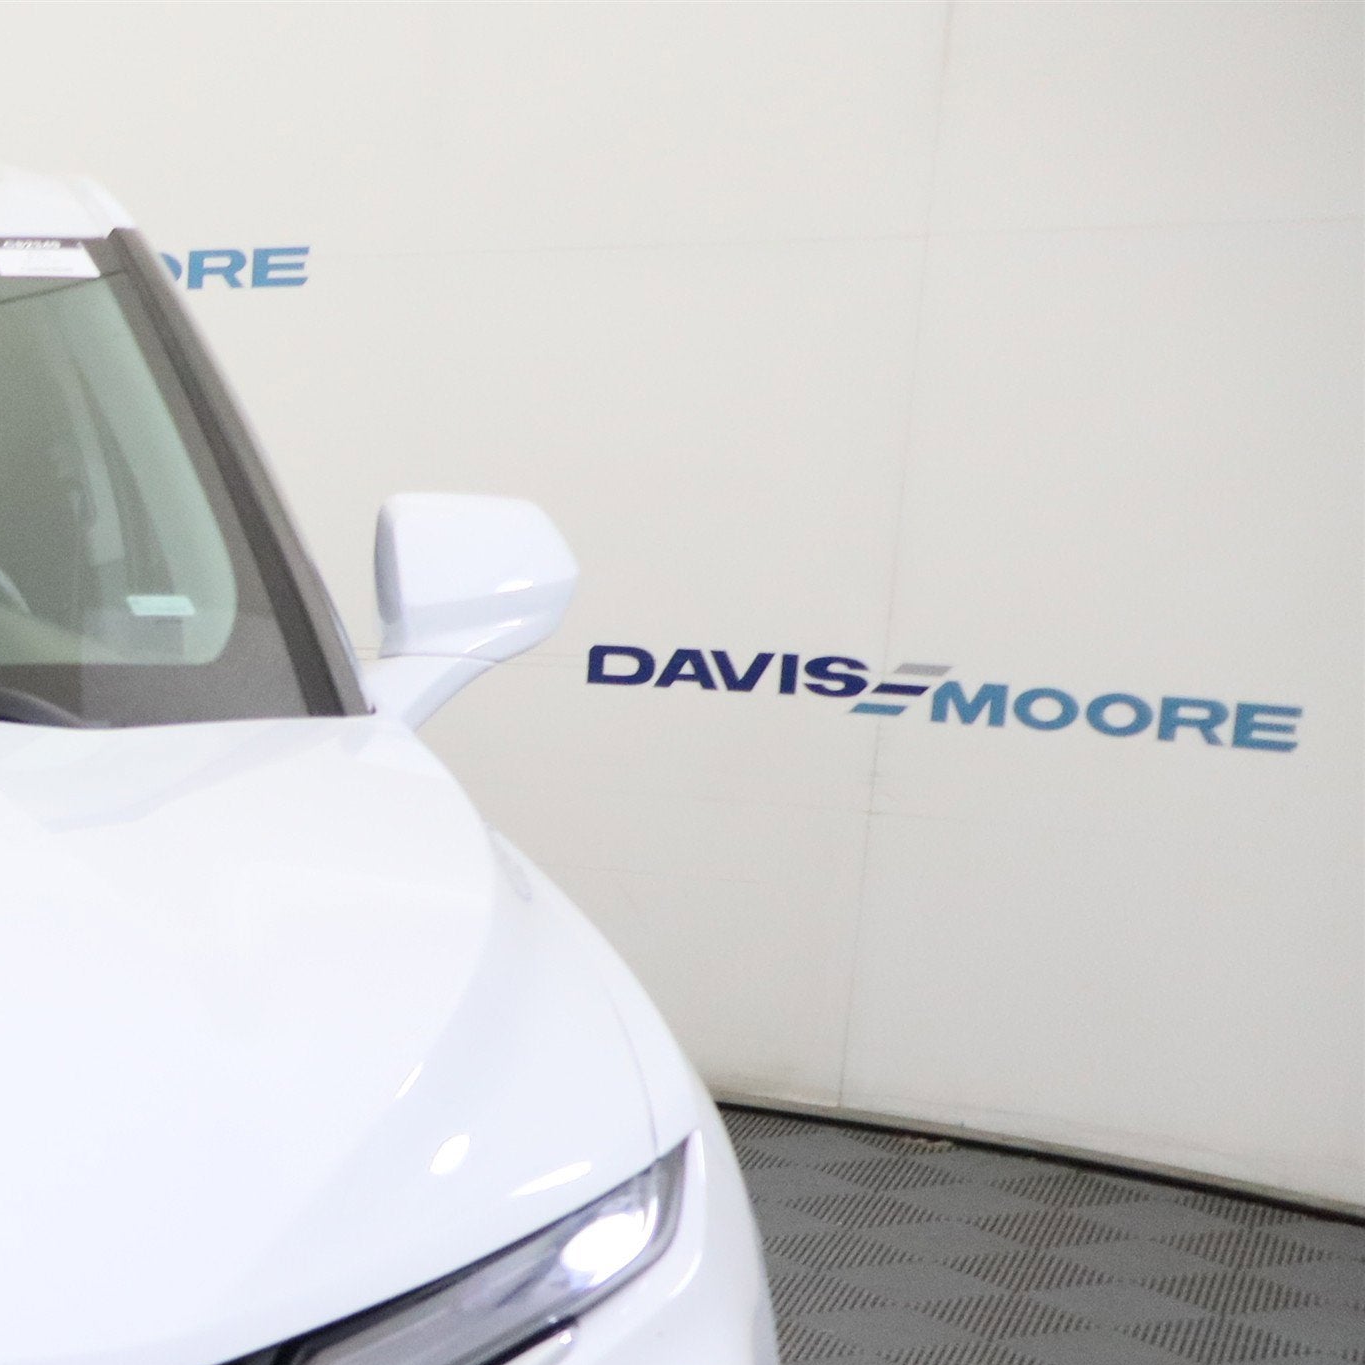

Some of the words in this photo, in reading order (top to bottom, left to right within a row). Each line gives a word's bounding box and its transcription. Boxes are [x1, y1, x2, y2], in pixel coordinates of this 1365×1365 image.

[161, 246, 310, 290] RE
[587, 644, 869, 697] DAVIS
[930, 680, 1303, 752] MOORE
